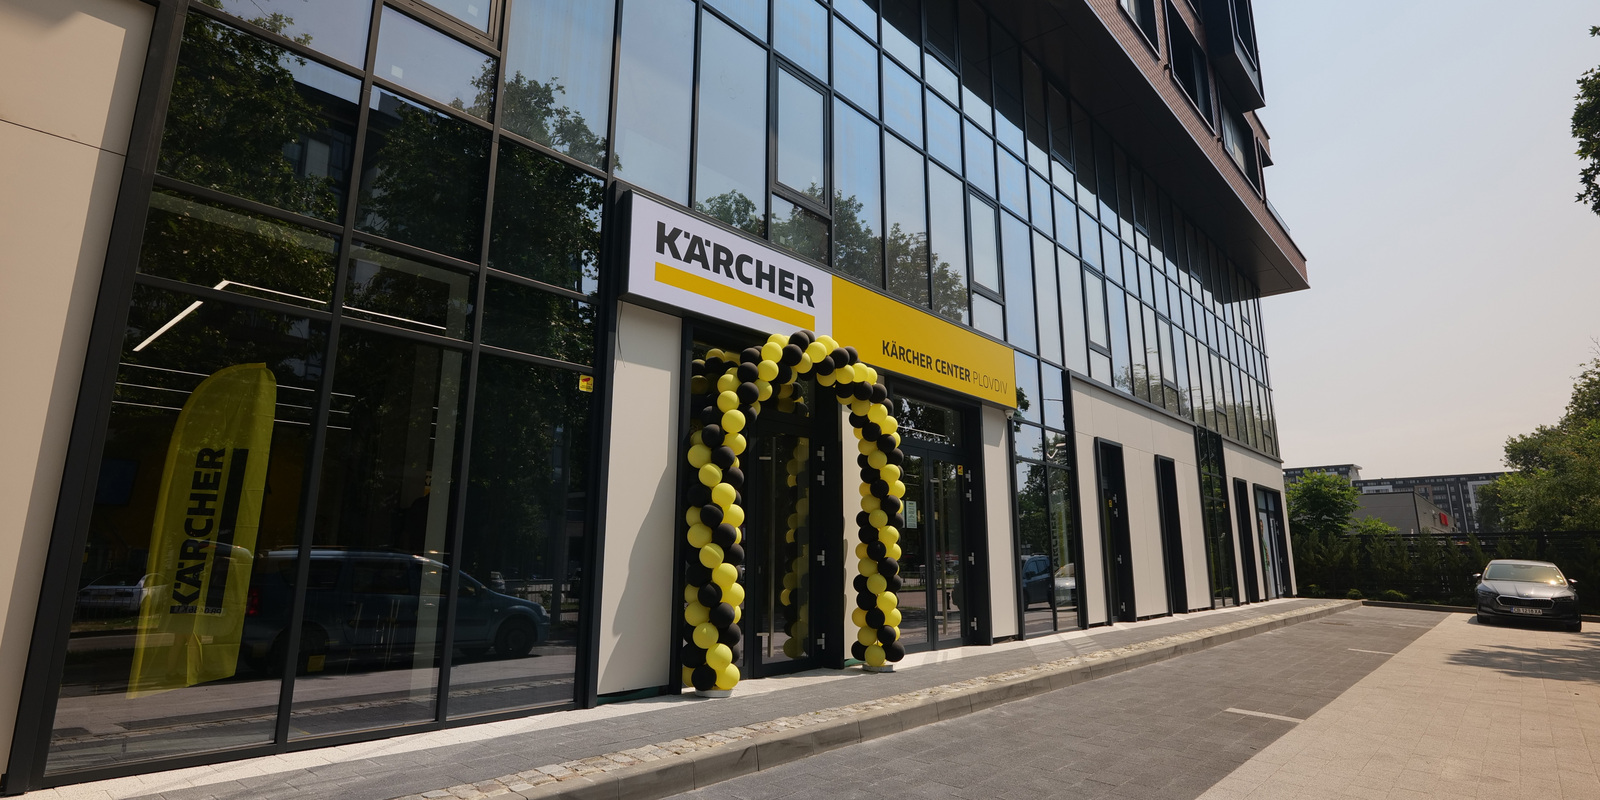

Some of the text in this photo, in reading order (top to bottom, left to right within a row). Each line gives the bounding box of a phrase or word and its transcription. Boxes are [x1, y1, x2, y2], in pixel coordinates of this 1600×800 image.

[656, 220, 815, 308] KÄRCHER
[882, 340, 1008, 395] KÄRCHER CENTER PLOVDIV
[170, 447, 226, 614] KÄRCHER
